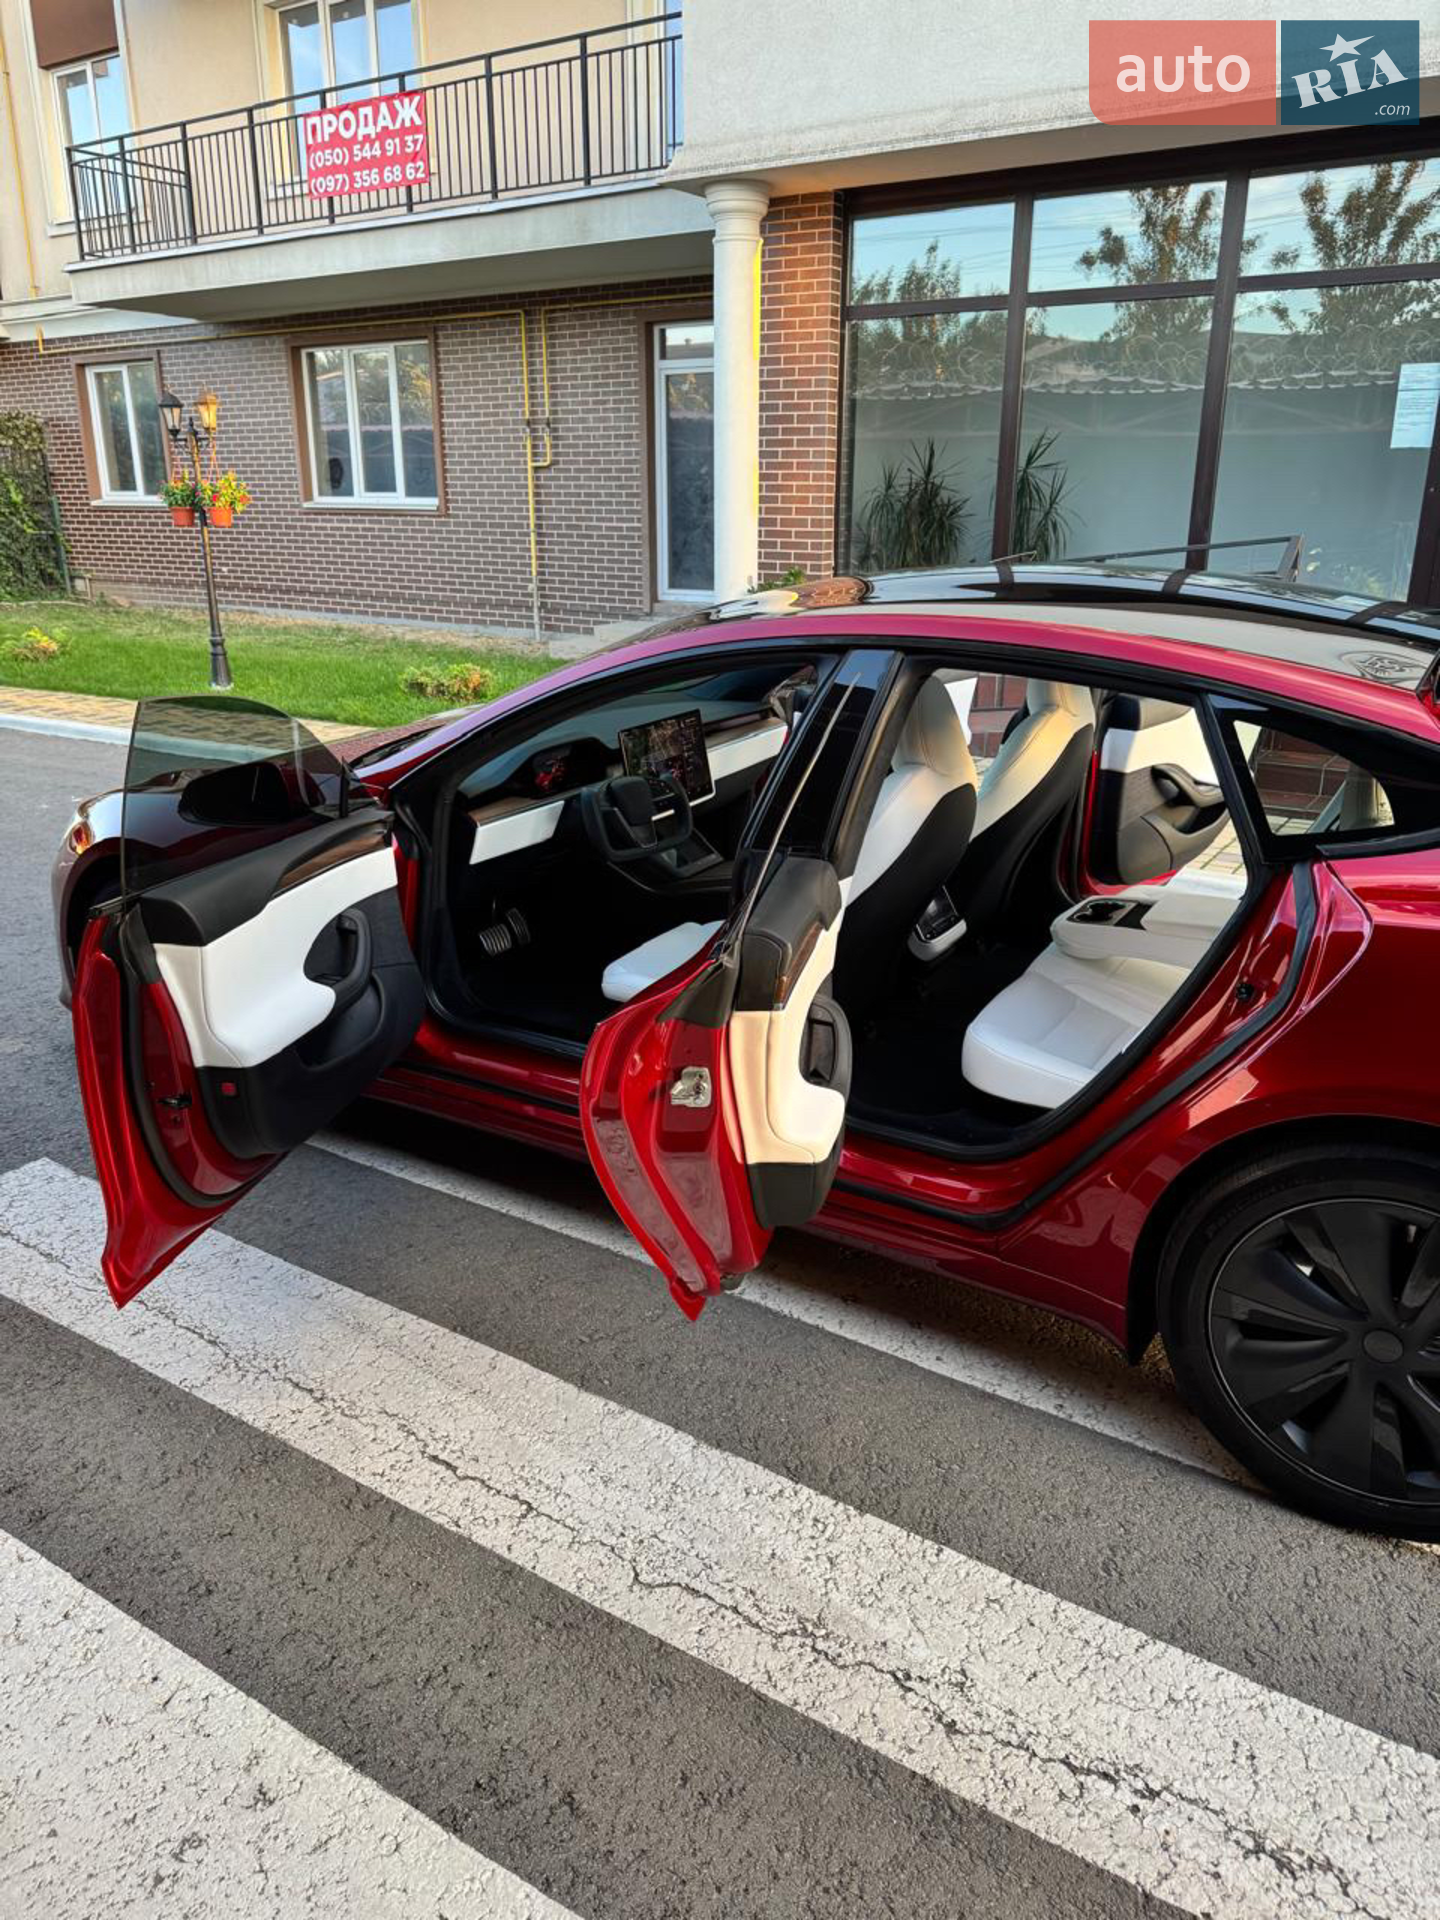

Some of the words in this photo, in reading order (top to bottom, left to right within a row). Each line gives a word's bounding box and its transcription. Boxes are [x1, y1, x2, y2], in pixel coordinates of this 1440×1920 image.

[307, 96, 422, 144] ПРОДАЖ
[309, 148, 349, 170] (050)
[353, 142, 381, 162] 544
[385, 137, 400, 156] 91
[404, 134, 423, 152] 37
[310, 173, 349, 195] (097)
[353, 169, 380, 188] 356
[383, 165, 402, 183] 68
[405, 162, 425, 180] 62
